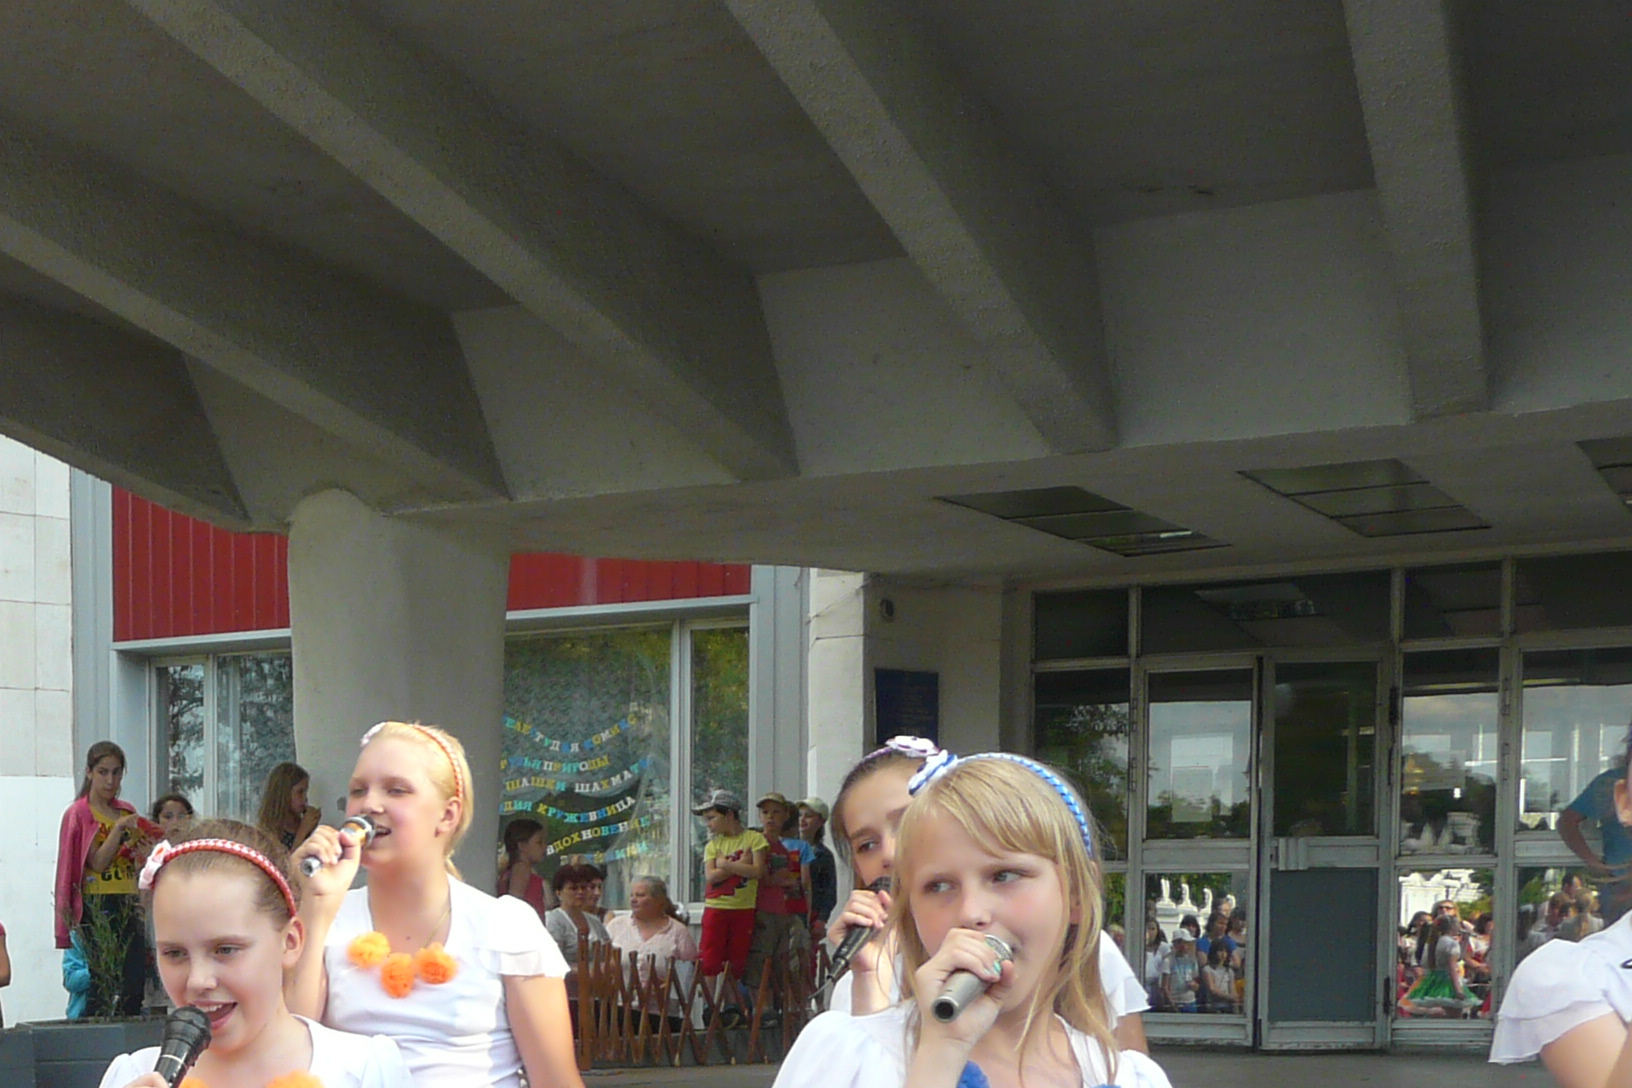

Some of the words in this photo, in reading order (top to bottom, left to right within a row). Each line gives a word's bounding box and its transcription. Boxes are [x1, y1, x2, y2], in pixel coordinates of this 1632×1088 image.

[583, 713, 638, 750] КОМИКС
[499, 756, 541, 770] РУЗЬЯ
[543, 755, 610, 773] ПРИРОДЫ
[506, 776, 566, 792] ШАШКИ
[537, 796, 636, 823] КРУЖЕВНИЦА
[546, 817, 651, 855] ВДОХНОВЕНИЕ
